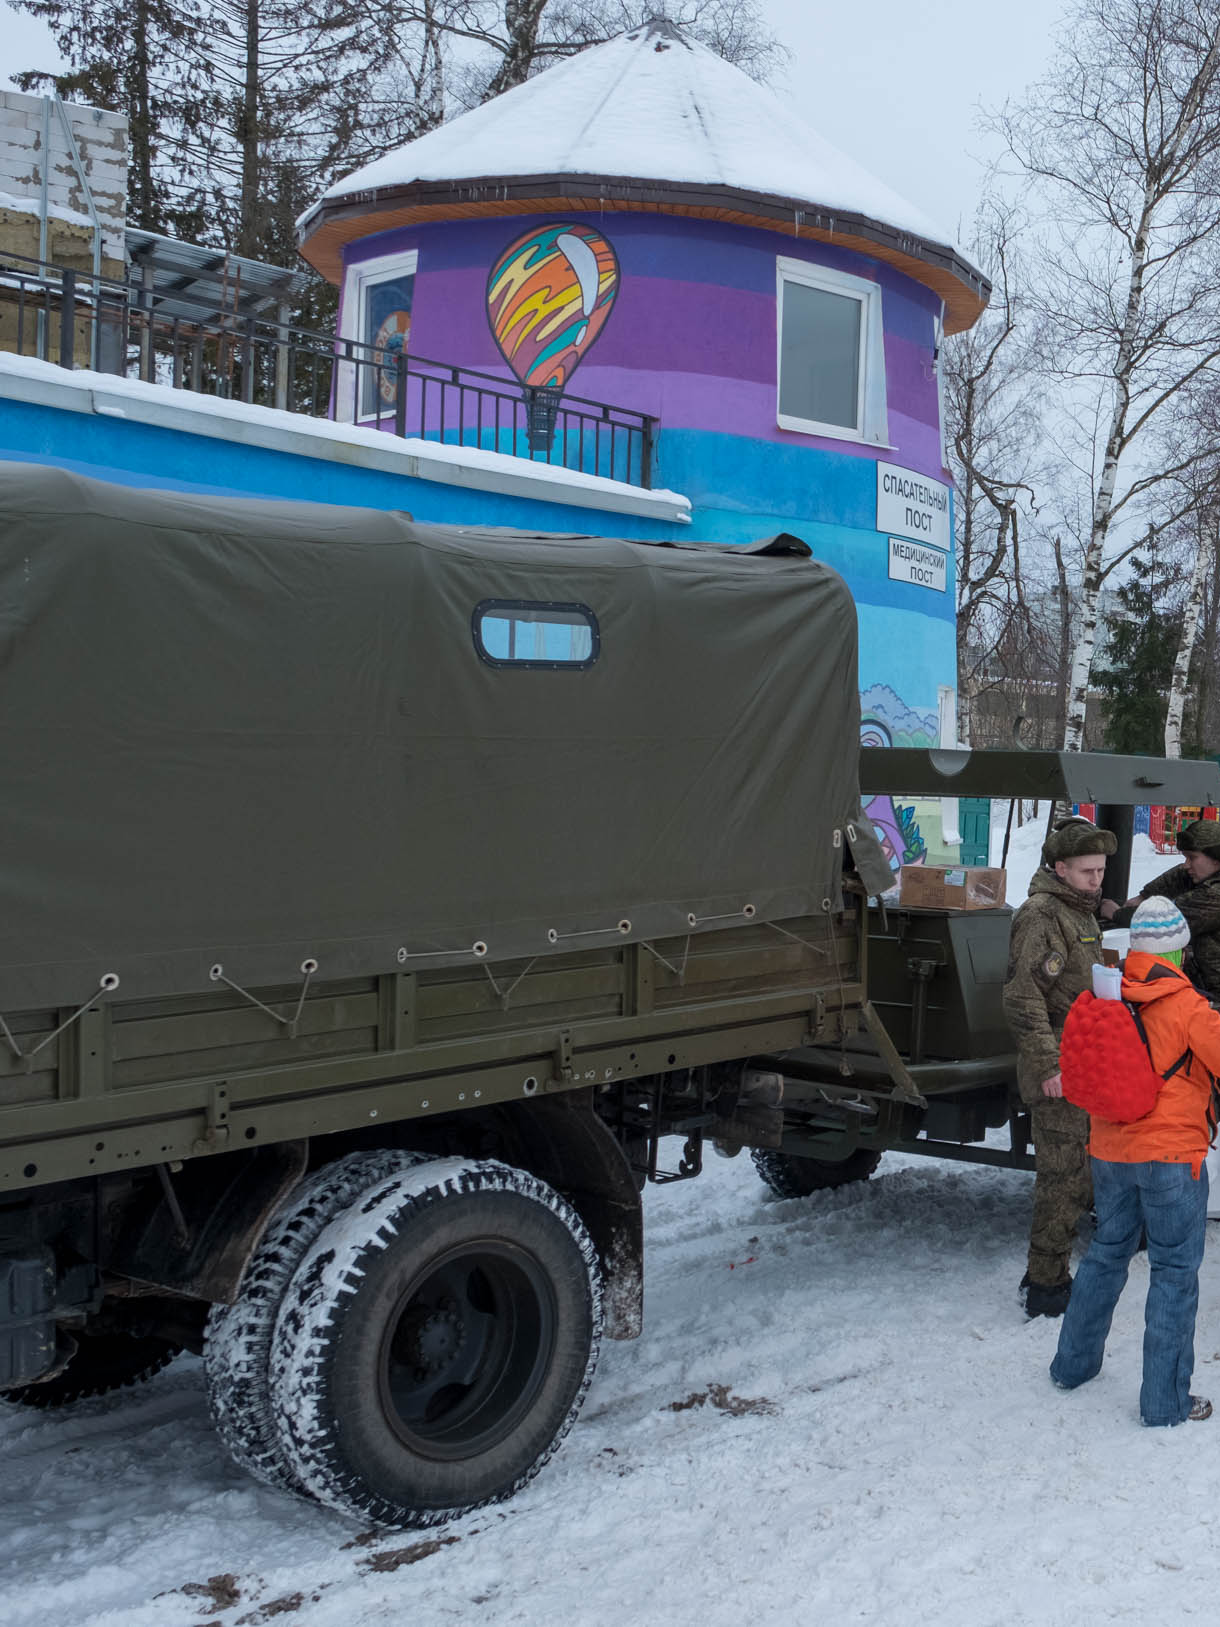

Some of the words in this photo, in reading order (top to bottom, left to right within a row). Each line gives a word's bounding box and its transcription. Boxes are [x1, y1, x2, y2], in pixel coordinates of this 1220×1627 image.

[883, 473, 947, 513] СПАСАТЕЛЬНЫЙ
[905, 507, 933, 532] ПОСТ
[892, 543, 944, 569] МЕДИЦИНСКИЙ
[910, 566, 934, 584] ПОСТ
